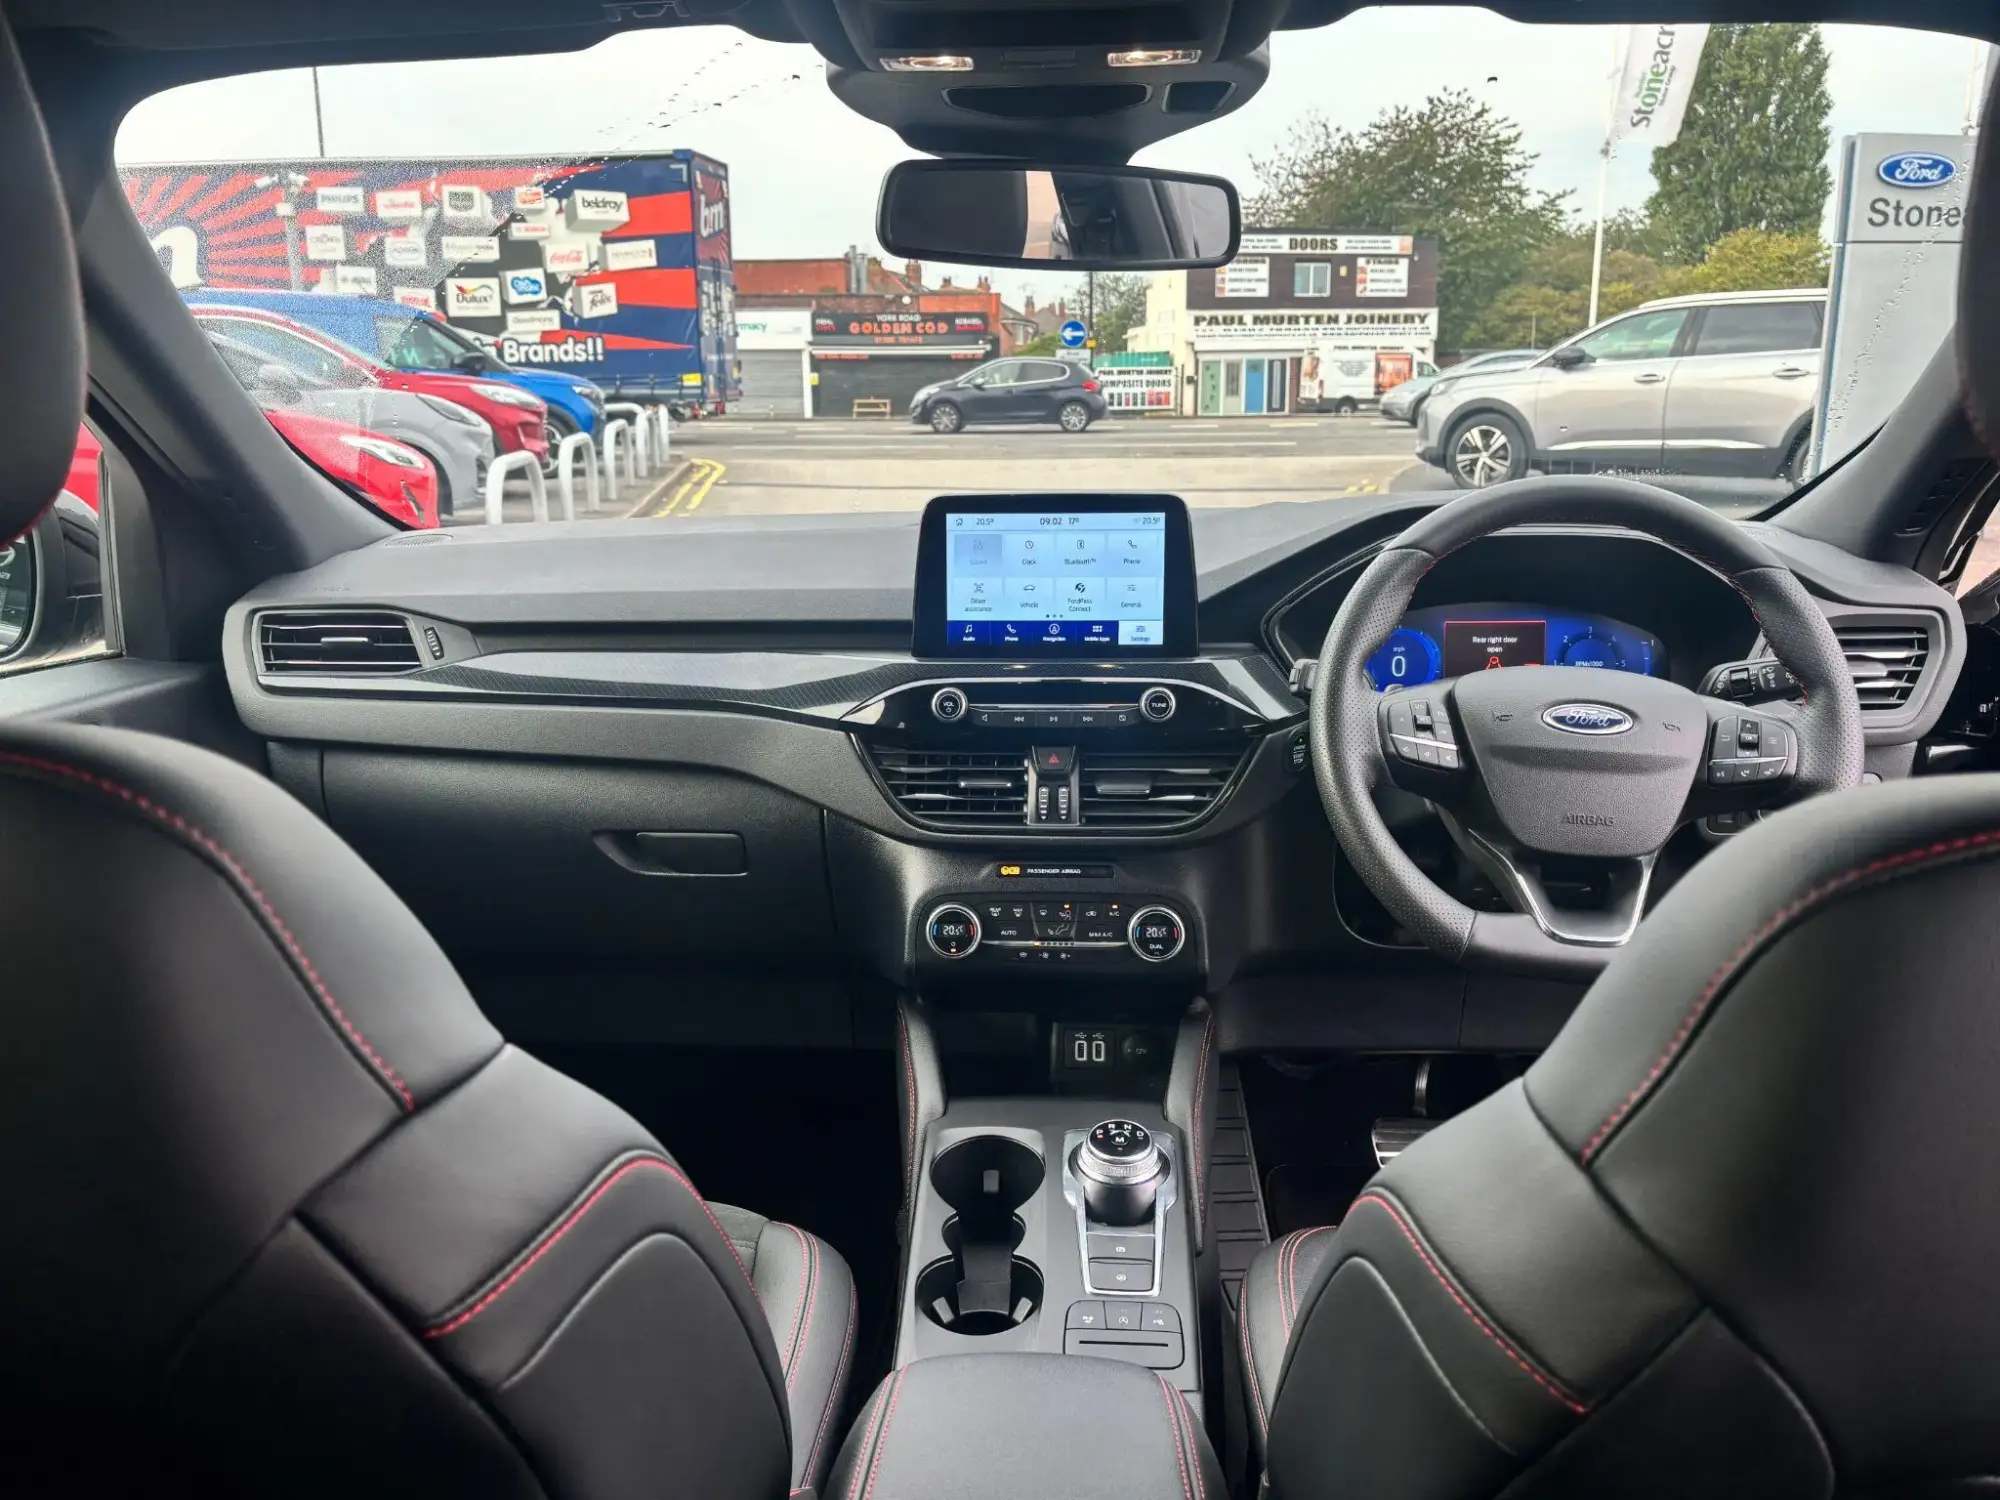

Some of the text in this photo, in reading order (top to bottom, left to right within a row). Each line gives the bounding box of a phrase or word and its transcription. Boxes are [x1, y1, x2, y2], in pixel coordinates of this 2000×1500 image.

[1894, 158, 1944, 180] Ford
[581, 196, 625, 212] beldray
[1867, 197, 1964, 228] Stone
[1289, 238, 1338, 250] DOORS
[898, 314, 921, 322] ROAD
[1193, 313, 1431, 326] PAUL MURTEN JOINERY
[849, 321, 949, 335] GOLDEN COD
[502, 338, 604, 363] Brands!!
[1588, 626, 1593, 634] 3
[1130, 635, 1151, 643] Settings
[1487, 636, 1502, 644] right
[1563, 635, 1568, 643] 2
[1391, 655, 1406, 677] 0
[1565, 706, 1611, 728] Ford
[1561, 813, 1614, 827] AIRBAG
